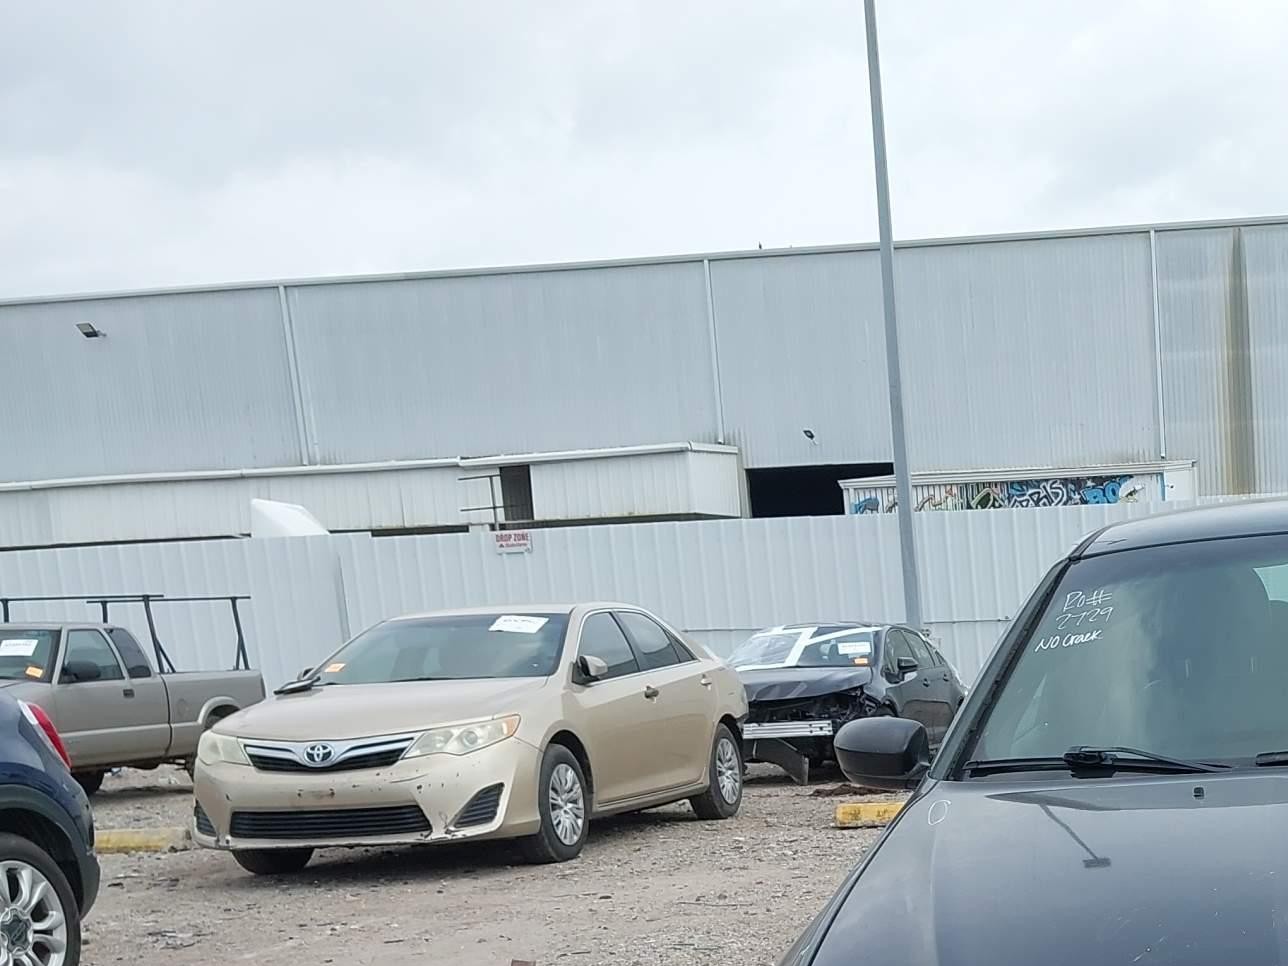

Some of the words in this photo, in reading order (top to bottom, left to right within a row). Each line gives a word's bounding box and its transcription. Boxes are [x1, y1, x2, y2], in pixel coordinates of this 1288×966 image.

[496, 534, 512, 542] DROP
[514, 533, 528, 541] ZONE
[1056, 606, 1114, 630] 2729
